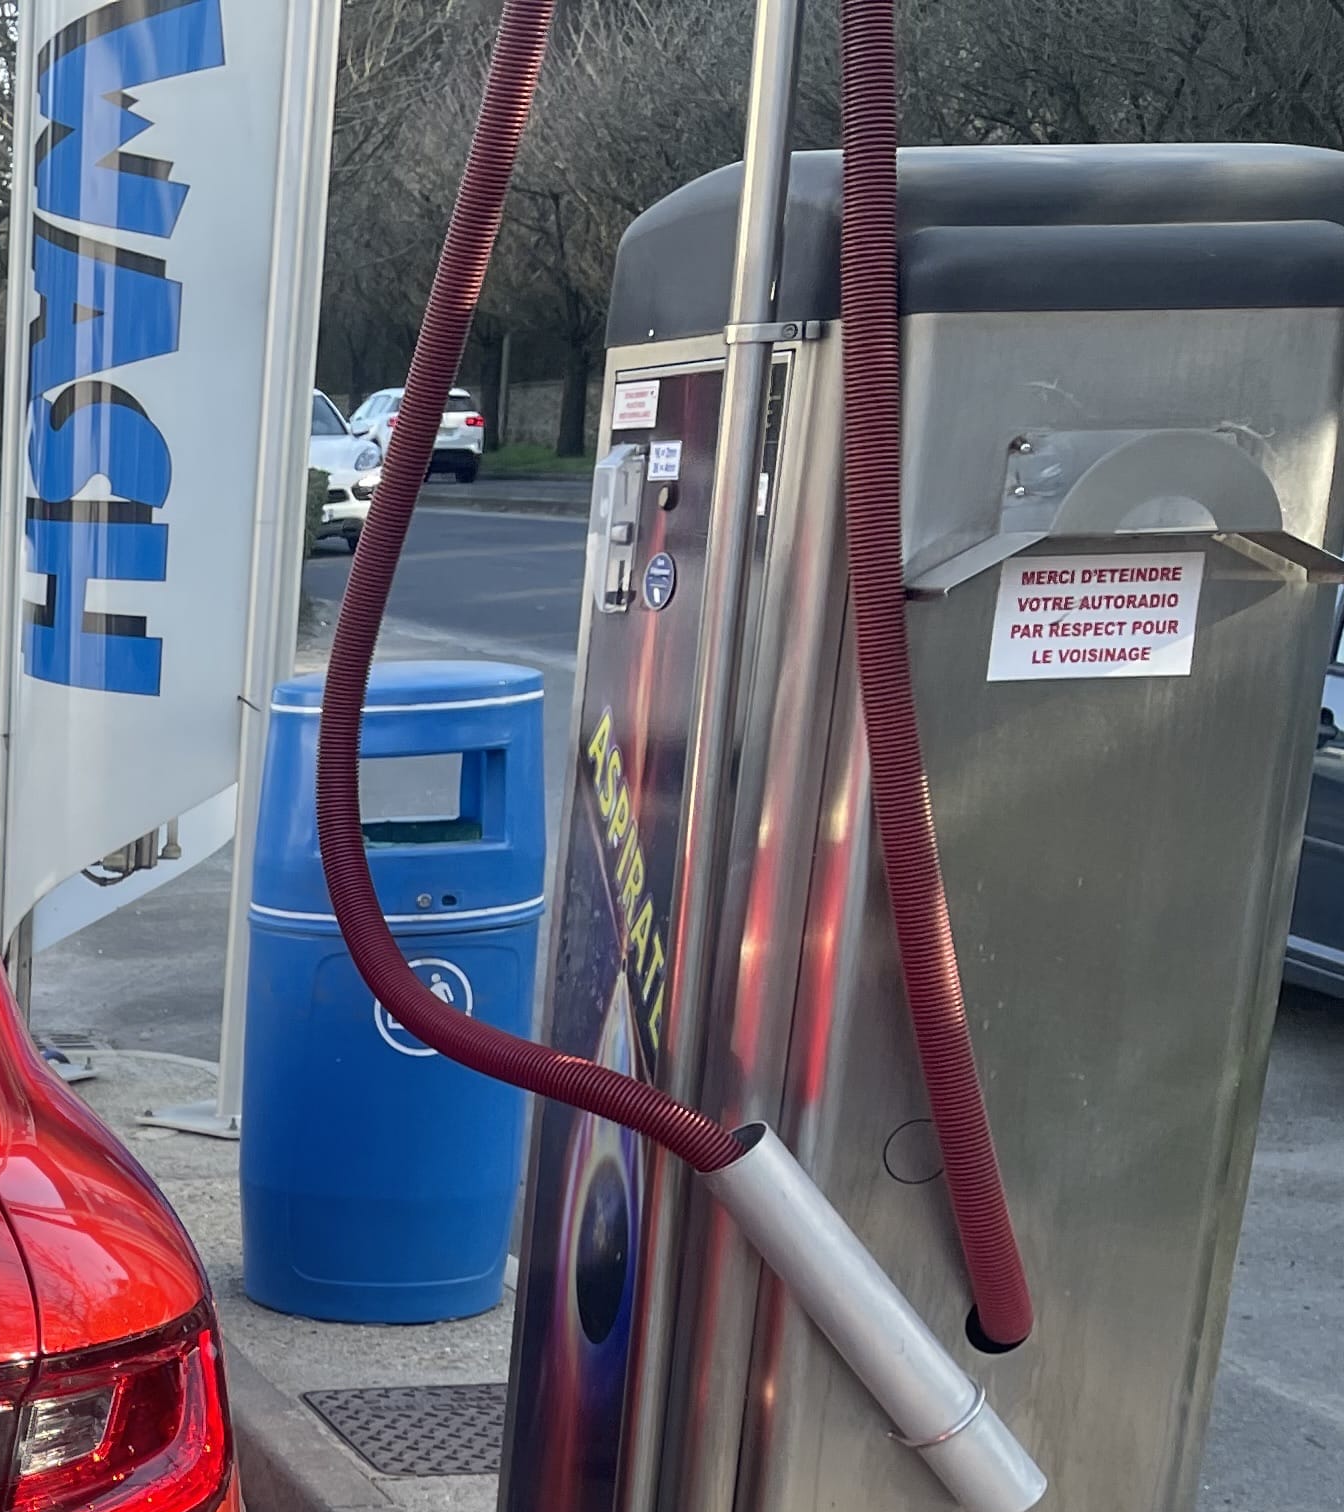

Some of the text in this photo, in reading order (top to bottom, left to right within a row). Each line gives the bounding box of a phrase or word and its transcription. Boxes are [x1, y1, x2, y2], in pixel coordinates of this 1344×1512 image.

[23, 0, 225, 696] WASH
[1021, 566, 1183, 586] MERCI D'ETEINDRE
[1017, 593, 1180, 612] VOTRE AUTORADIO
[1010, 620, 1179, 639] PAR RESPECT POUR
[1031, 647, 1152, 665] LE VOISINAGE
